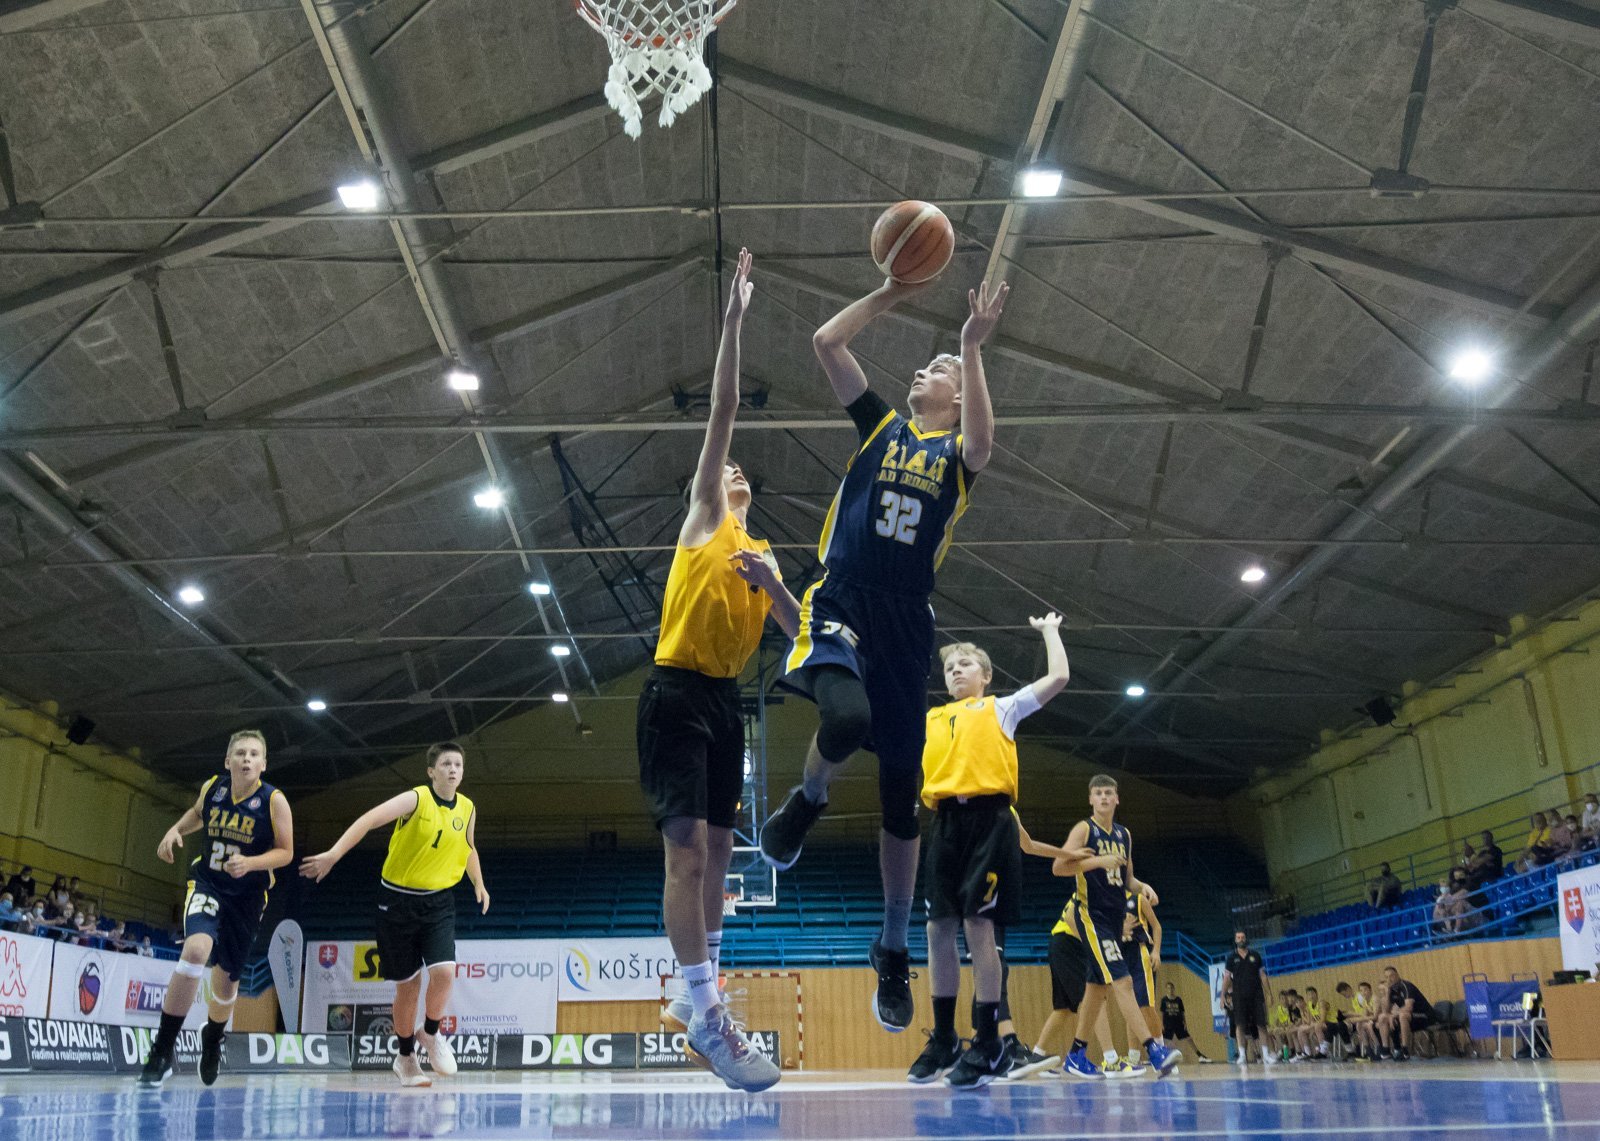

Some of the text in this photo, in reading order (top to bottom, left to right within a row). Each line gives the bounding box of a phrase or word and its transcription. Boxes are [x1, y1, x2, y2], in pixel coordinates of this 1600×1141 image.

[875, 490, 923, 545] 32
[208, 806, 256, 836] ŽIAR
[431, 829, 443, 849] 1
[983, 871, 998, 902] 7
[188, 893, 220, 917] 23
[455, 962, 553, 982] risgroup
[461, 1015, 518, 1023] MINISTERSTVO
[28, 1019, 103, 1048] SLOVAKIA
[120, 1026, 159, 1064] DA
[359, 1035, 482, 1054] SLOKIA
[248, 1033, 330, 1064] DAG
[357, 1054, 393, 1064] riadime
[456, 1054, 488, 1066] stavby
[522, 1034, 612, 1065] DAG
[643, 1054, 679, 1063] riadime
